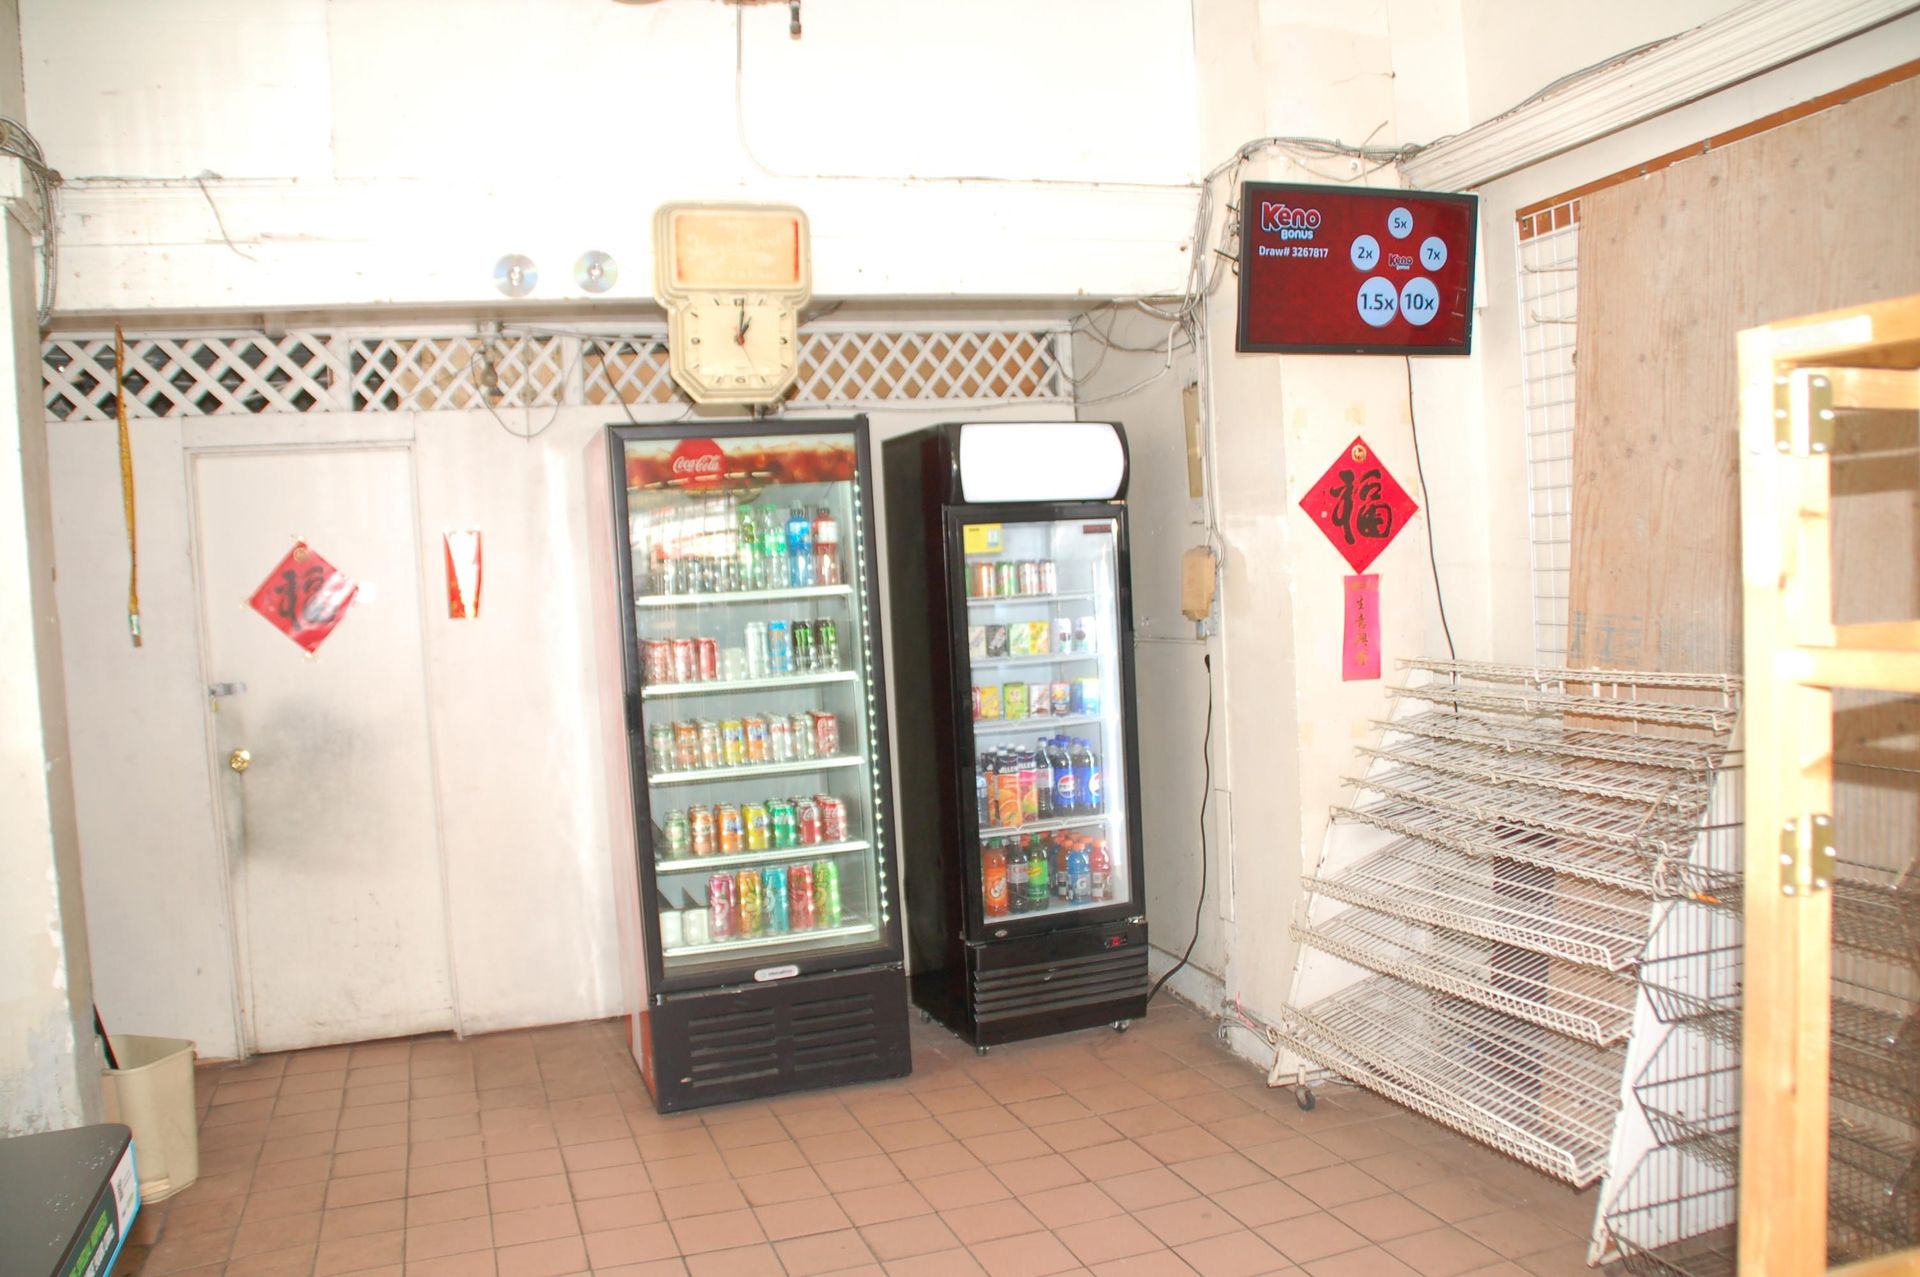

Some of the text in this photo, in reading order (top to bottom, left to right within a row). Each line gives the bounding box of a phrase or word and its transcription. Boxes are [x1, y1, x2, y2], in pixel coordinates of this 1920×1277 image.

[1261, 201, 1321, 232] Keno
[1393, 216, 1408, 230] 5x
[1258, 245, 1329, 259] Draw# 3267817
[1357, 246, 1373, 260] 2x
[1427, 248, 1441, 261] 7x
[1388, 253, 1413, 267] Keno
[1360, 293, 1394, 311] 1.5x
[1405, 293, 1435, 311] 10x
[1329, 468, 1393, 545] 福
